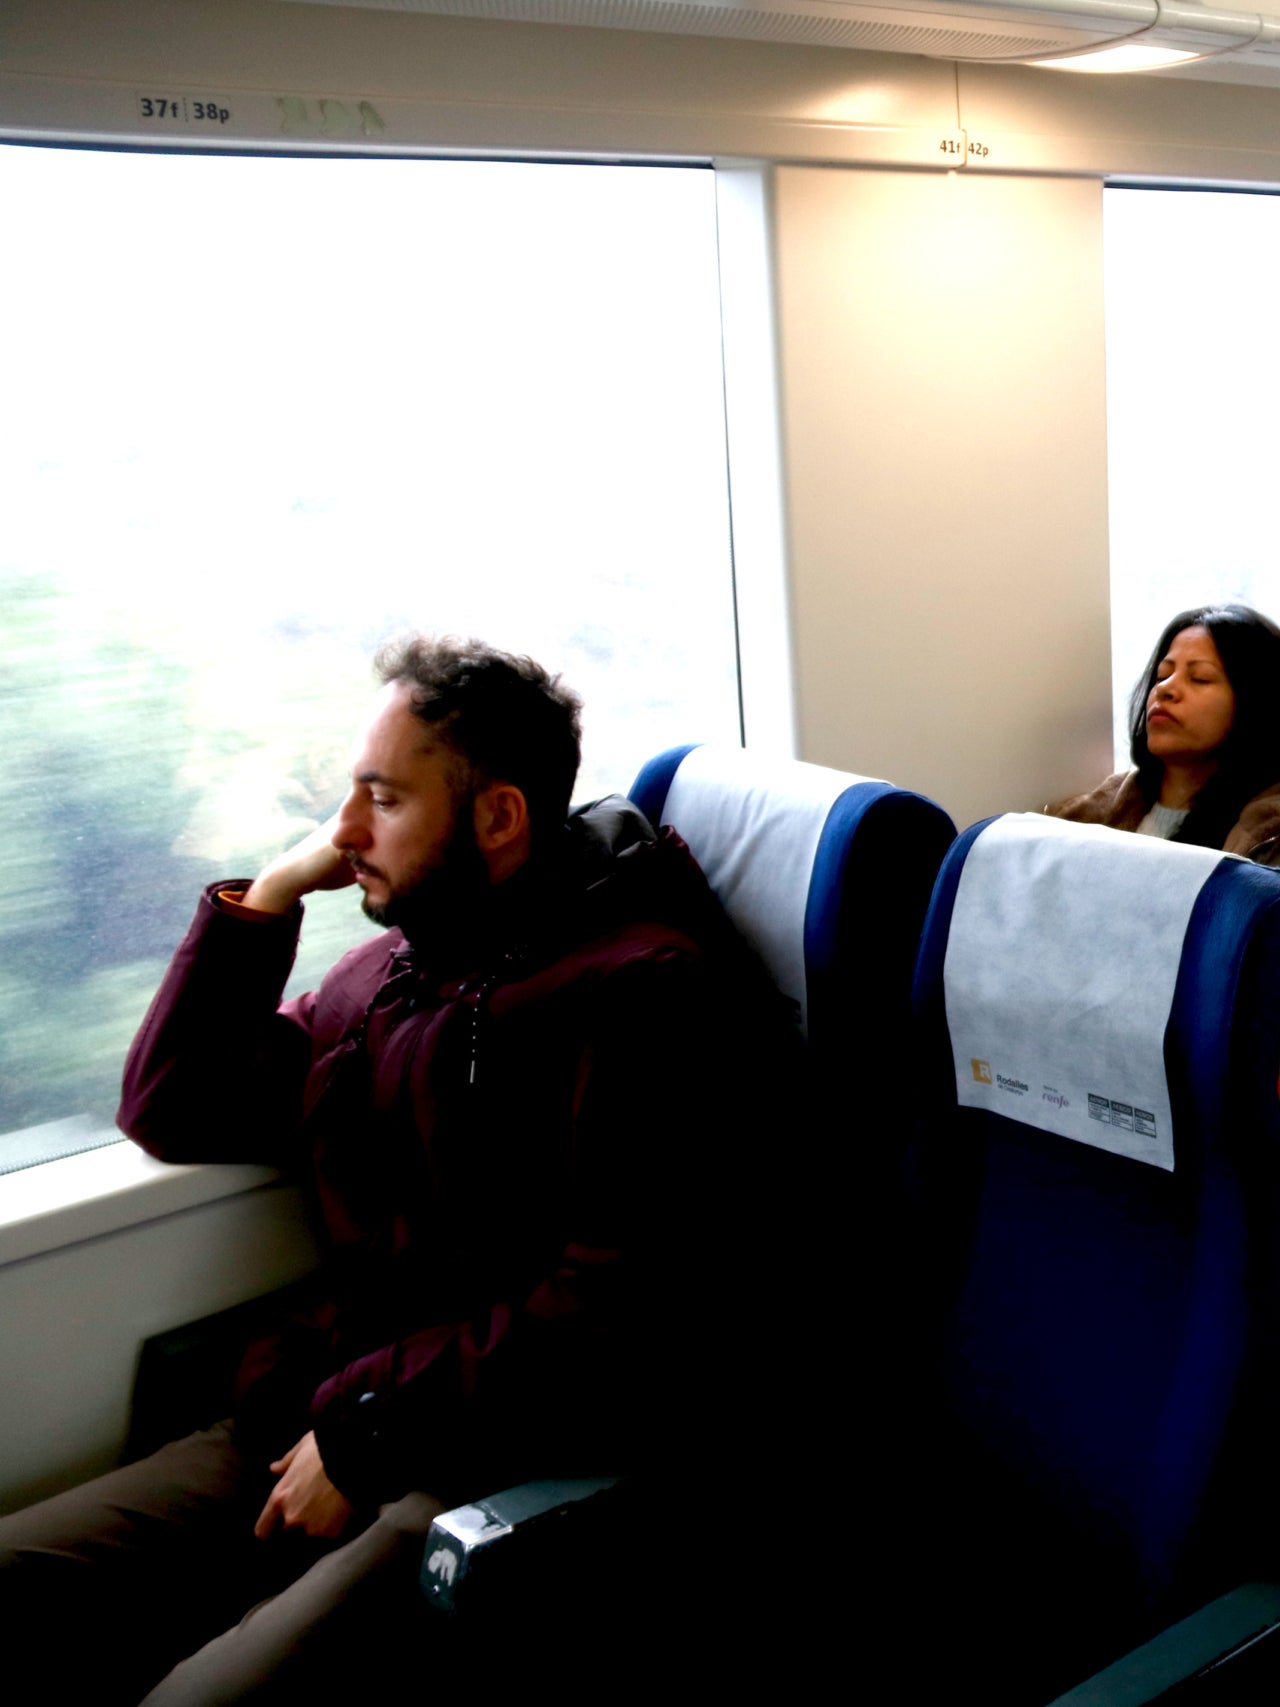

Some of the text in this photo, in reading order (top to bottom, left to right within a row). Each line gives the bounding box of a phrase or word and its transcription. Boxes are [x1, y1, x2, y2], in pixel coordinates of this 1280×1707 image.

[141, 98, 230, 124] 37f 38p
[940, 140, 989, 157] 41f 42p
